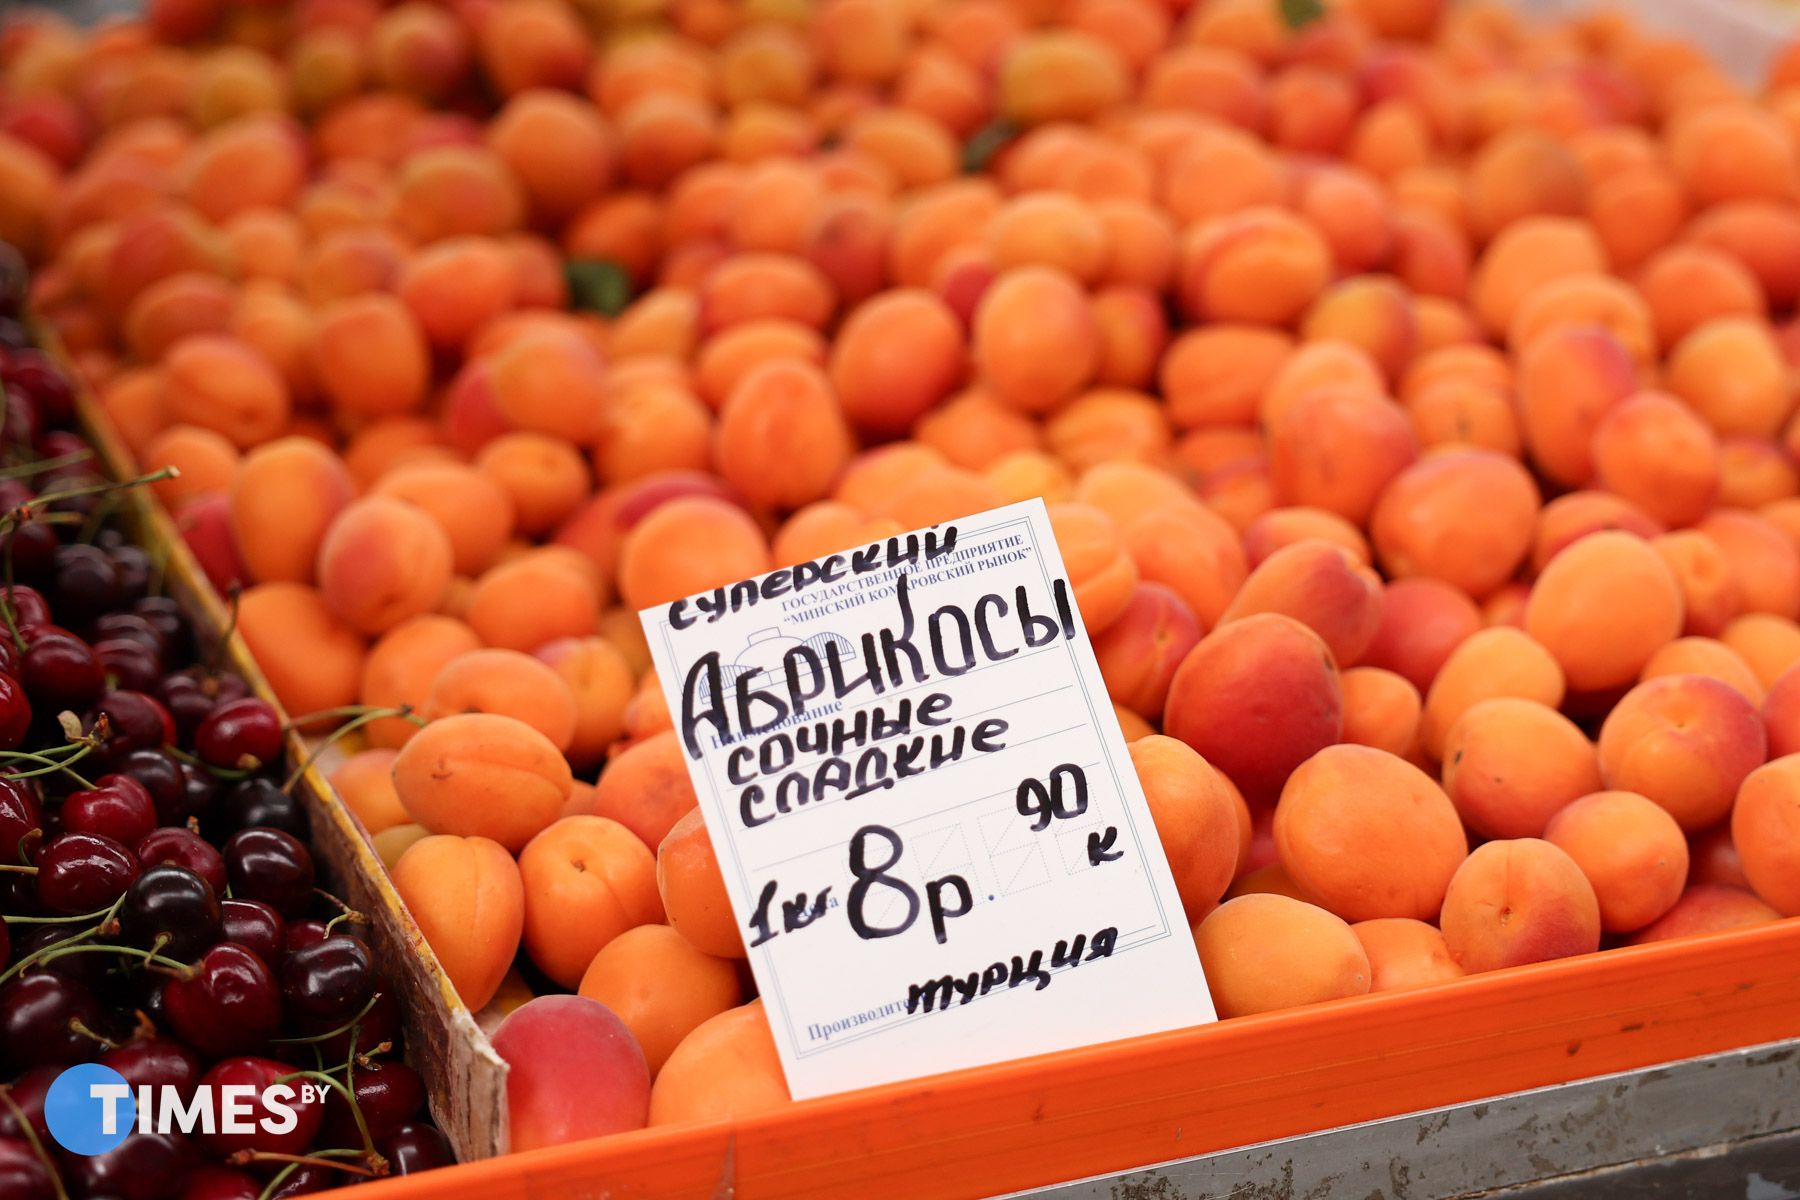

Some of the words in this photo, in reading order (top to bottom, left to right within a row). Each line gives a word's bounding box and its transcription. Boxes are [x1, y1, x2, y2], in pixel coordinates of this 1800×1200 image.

[782, 561, 923, 612] ГОСУДАРСТВЕННОЕ
[925, 534, 1024, 571] ПРЕДПРИЯТИЕ
[1015, 763, 1089, 832] 90
